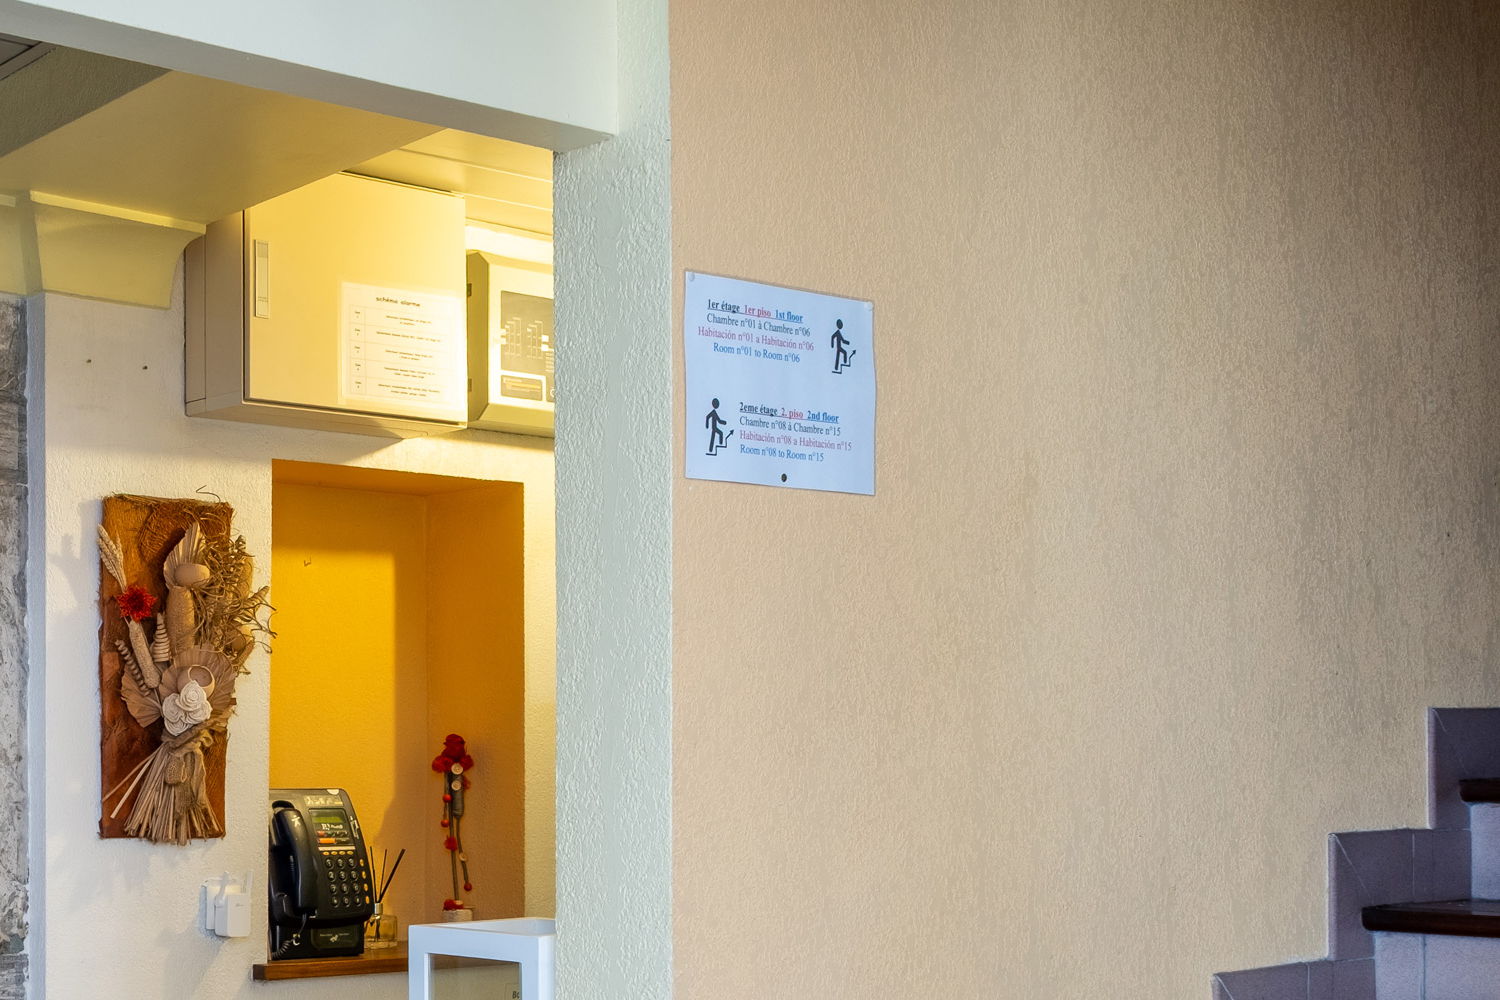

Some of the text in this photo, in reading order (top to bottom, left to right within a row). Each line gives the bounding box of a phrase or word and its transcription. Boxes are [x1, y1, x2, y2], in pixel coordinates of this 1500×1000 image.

[707, 299, 804, 323] 1er étage 1er piso 1st floor
[706, 312, 739, 327] Chambre
[740, 318, 756, 329] n°01
[763, 321, 793, 335] Chambre
[794, 327, 811, 338] n°06
[698, 326, 737, 340] Habitación
[738, 332, 754, 342] n°01
[762, 334, 797, 350] Habitación
[798, 341, 814, 352] n°06
[713, 342, 801, 364] Room n°01 to Room n°06
[740, 402, 759, 413] 2eme
[760, 404, 778, 417] étage
[788, 408, 804, 420] piso
[807, 410, 820, 421] 2nd
[822, 412, 840, 424] floor
[740, 416, 770, 429] Chambre
[770, 420, 787, 430] n°08
[794, 422, 824, 435] Chambre
[825, 426, 841, 437] n°15
[740, 430, 775, 444] Habitación
[776, 434, 792, 444] n°08
[800, 436, 836, 450] Habitación
[836, 441, 852, 452] n°15
[740, 444, 824, 462] Room n°08 to Room n°15
